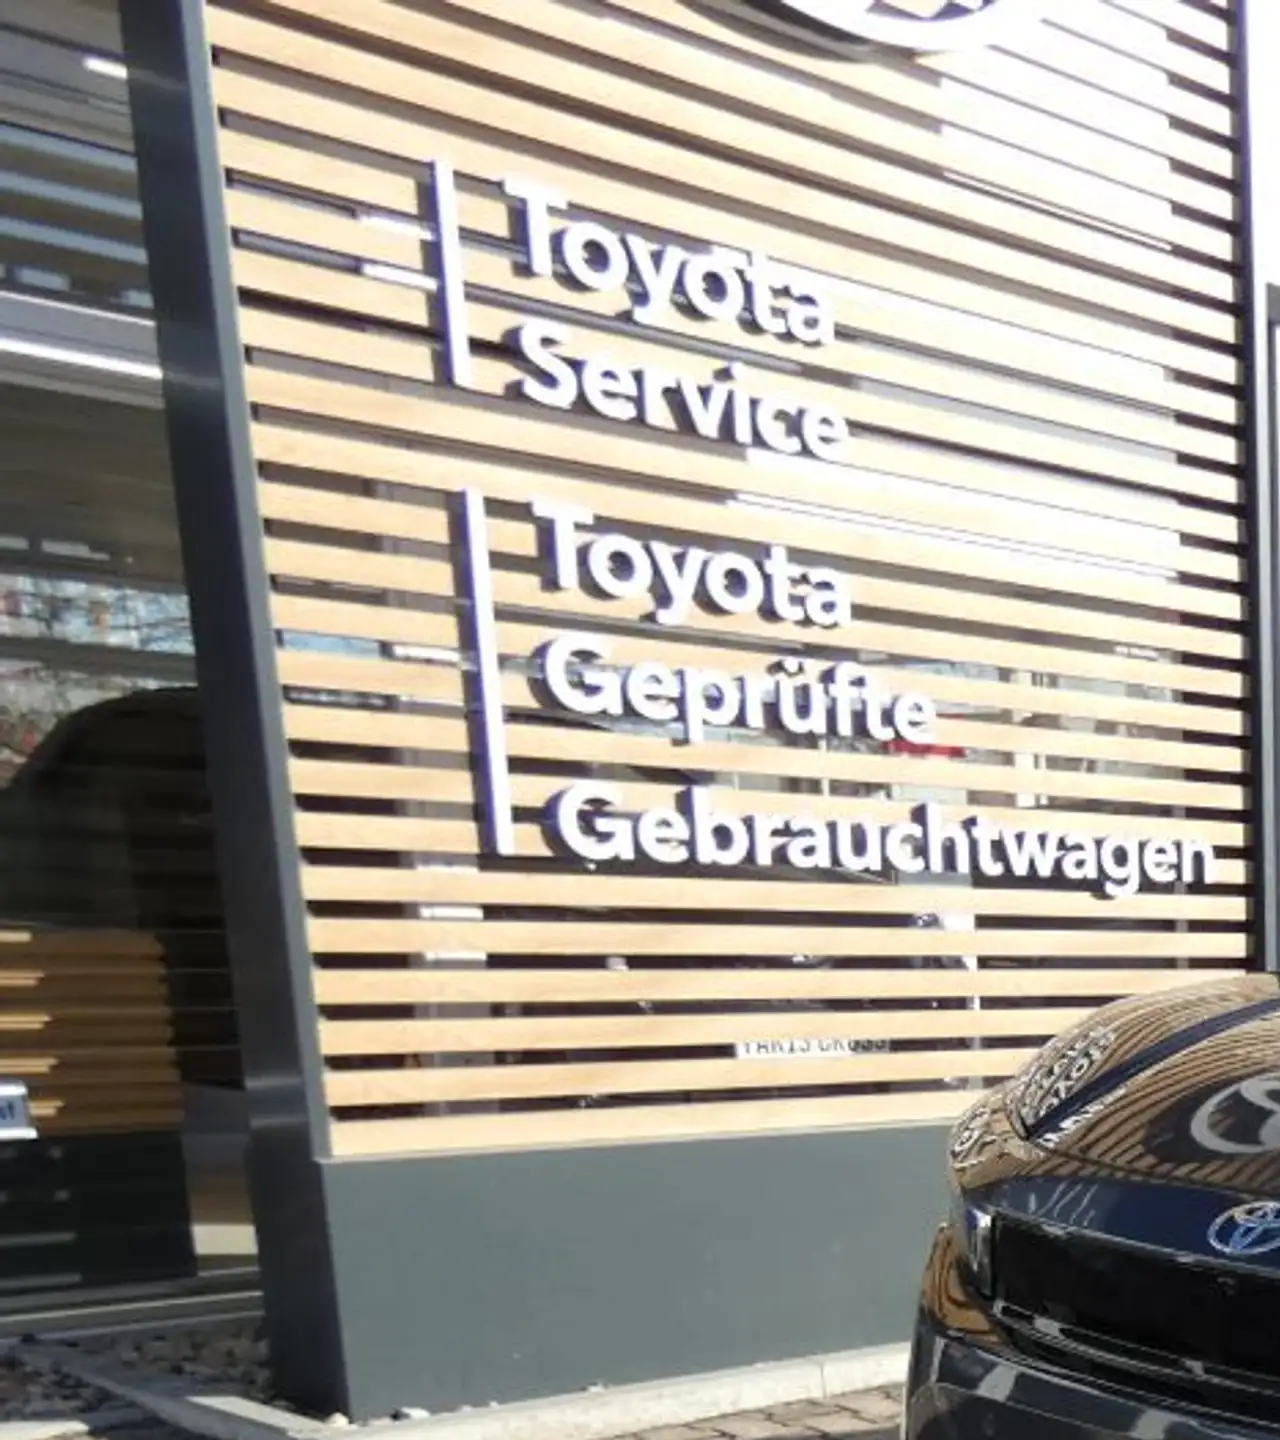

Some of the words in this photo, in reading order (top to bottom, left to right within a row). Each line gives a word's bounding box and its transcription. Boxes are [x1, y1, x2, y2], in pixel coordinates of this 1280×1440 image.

[502, 178, 837, 345] Toyota
[519, 320, 850, 459] Service
[531, 498, 853, 627] Toyota
[541, 635, 936, 745] Geprüfte
[556, 783, 1214, 896] Gebrauchtwagen
